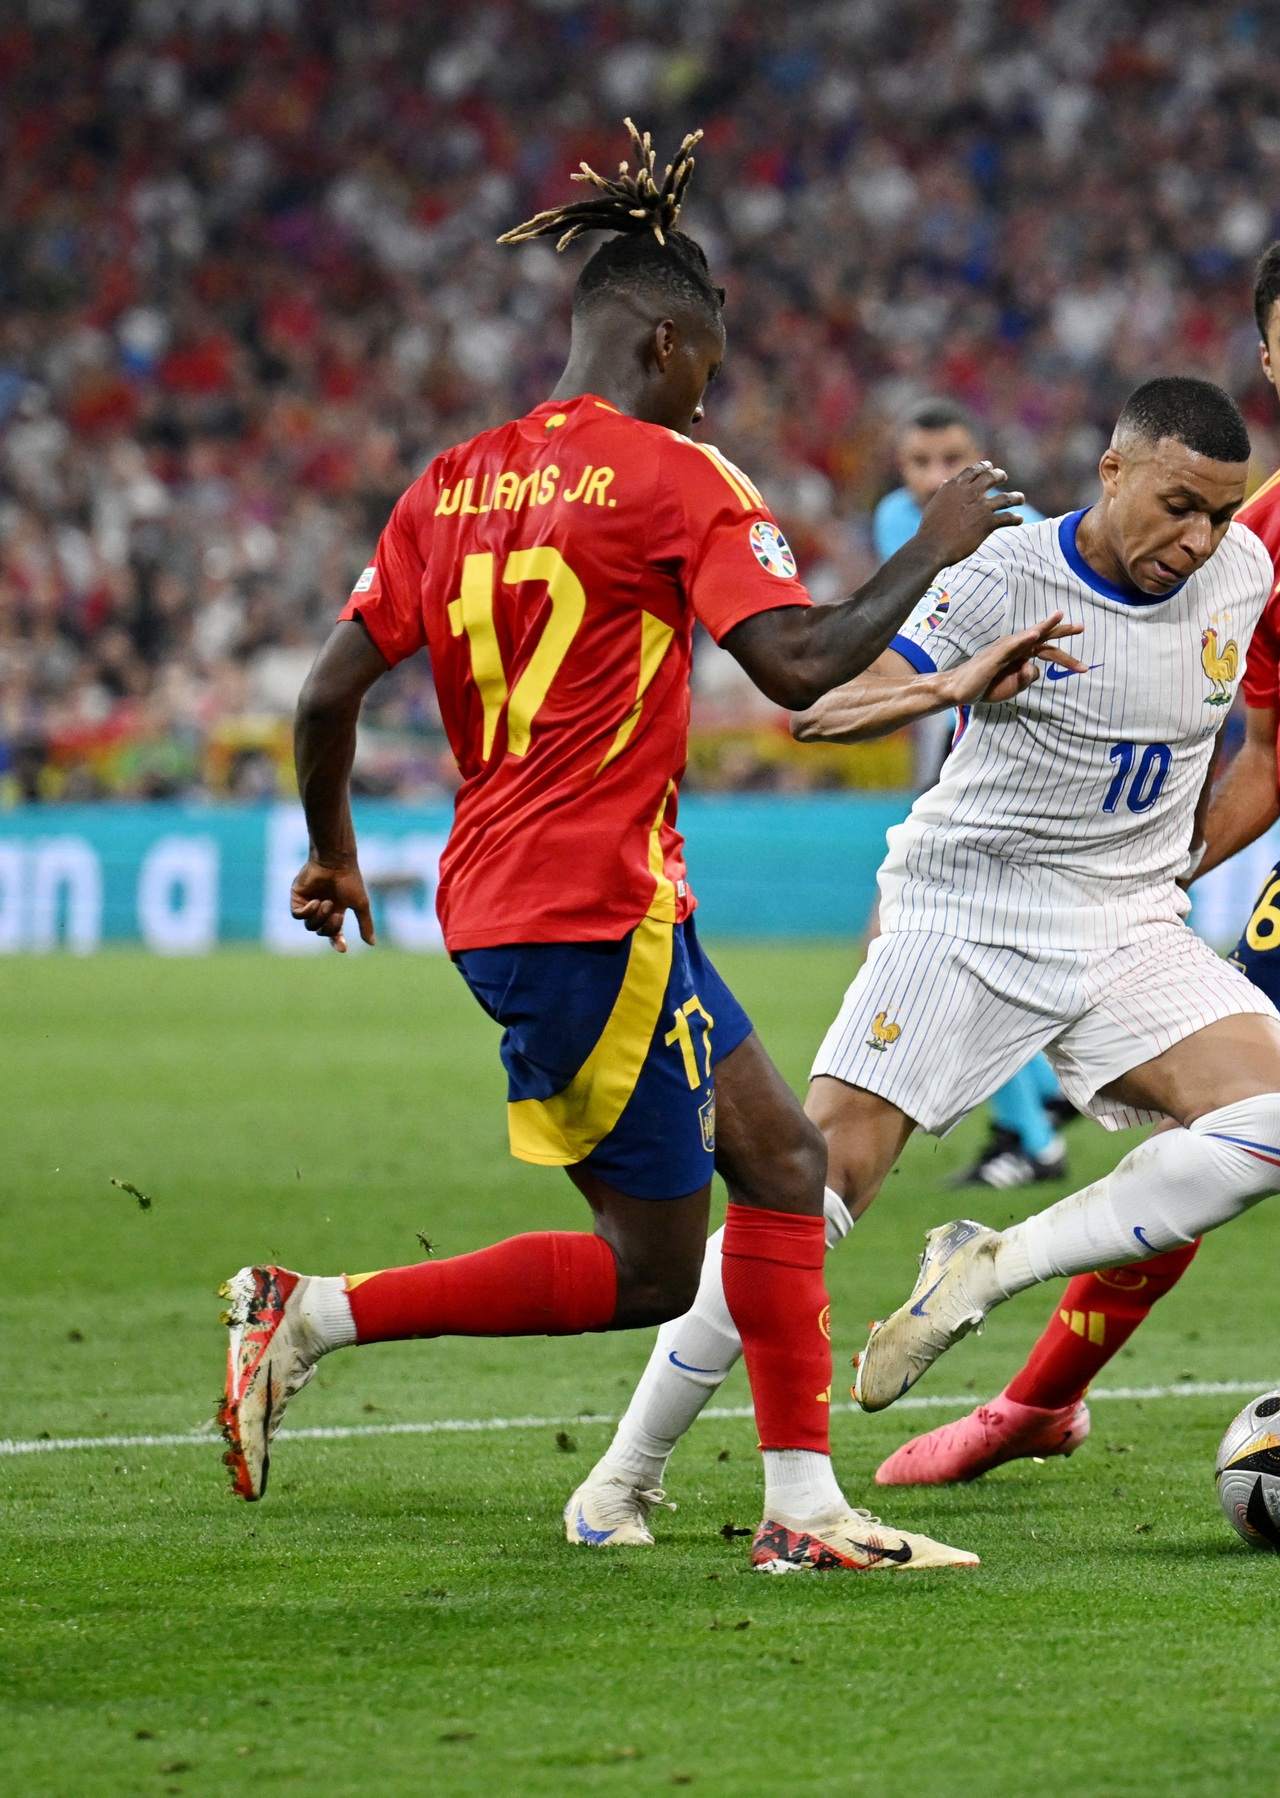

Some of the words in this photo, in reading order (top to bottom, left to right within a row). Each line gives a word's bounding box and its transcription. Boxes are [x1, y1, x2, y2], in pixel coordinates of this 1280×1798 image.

[434, 464, 560, 516] WLLIAMS
[563, 465, 617, 507] JR.
[447, 546, 587, 762] 17
[1102, 741, 1172, 814] 10
[665, 994, 714, 1090] 17
